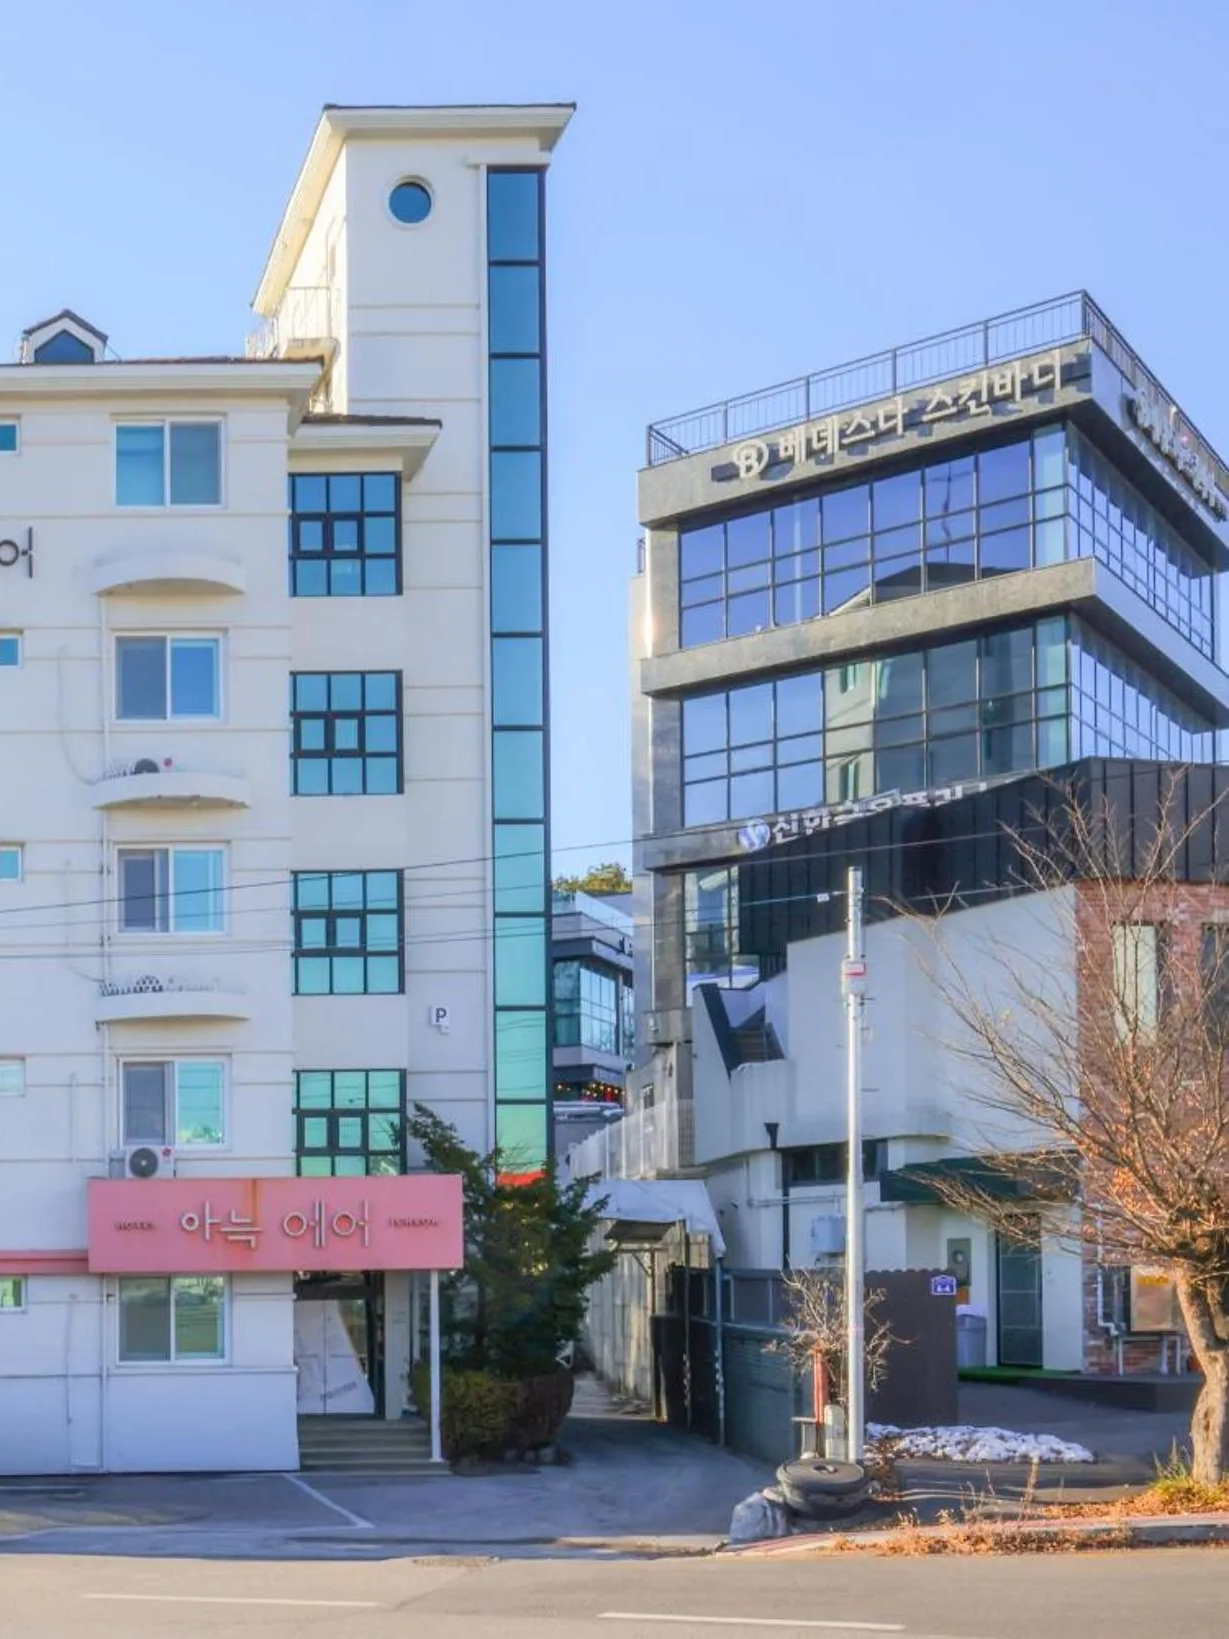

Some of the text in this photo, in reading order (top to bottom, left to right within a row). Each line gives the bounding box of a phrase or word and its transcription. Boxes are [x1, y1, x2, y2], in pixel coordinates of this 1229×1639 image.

[778, 348, 1062, 466] 베데스다 스킨바디
[435, 1007, 447, 1024] P
[181, 1198, 370, 1249] 아늑 에어
